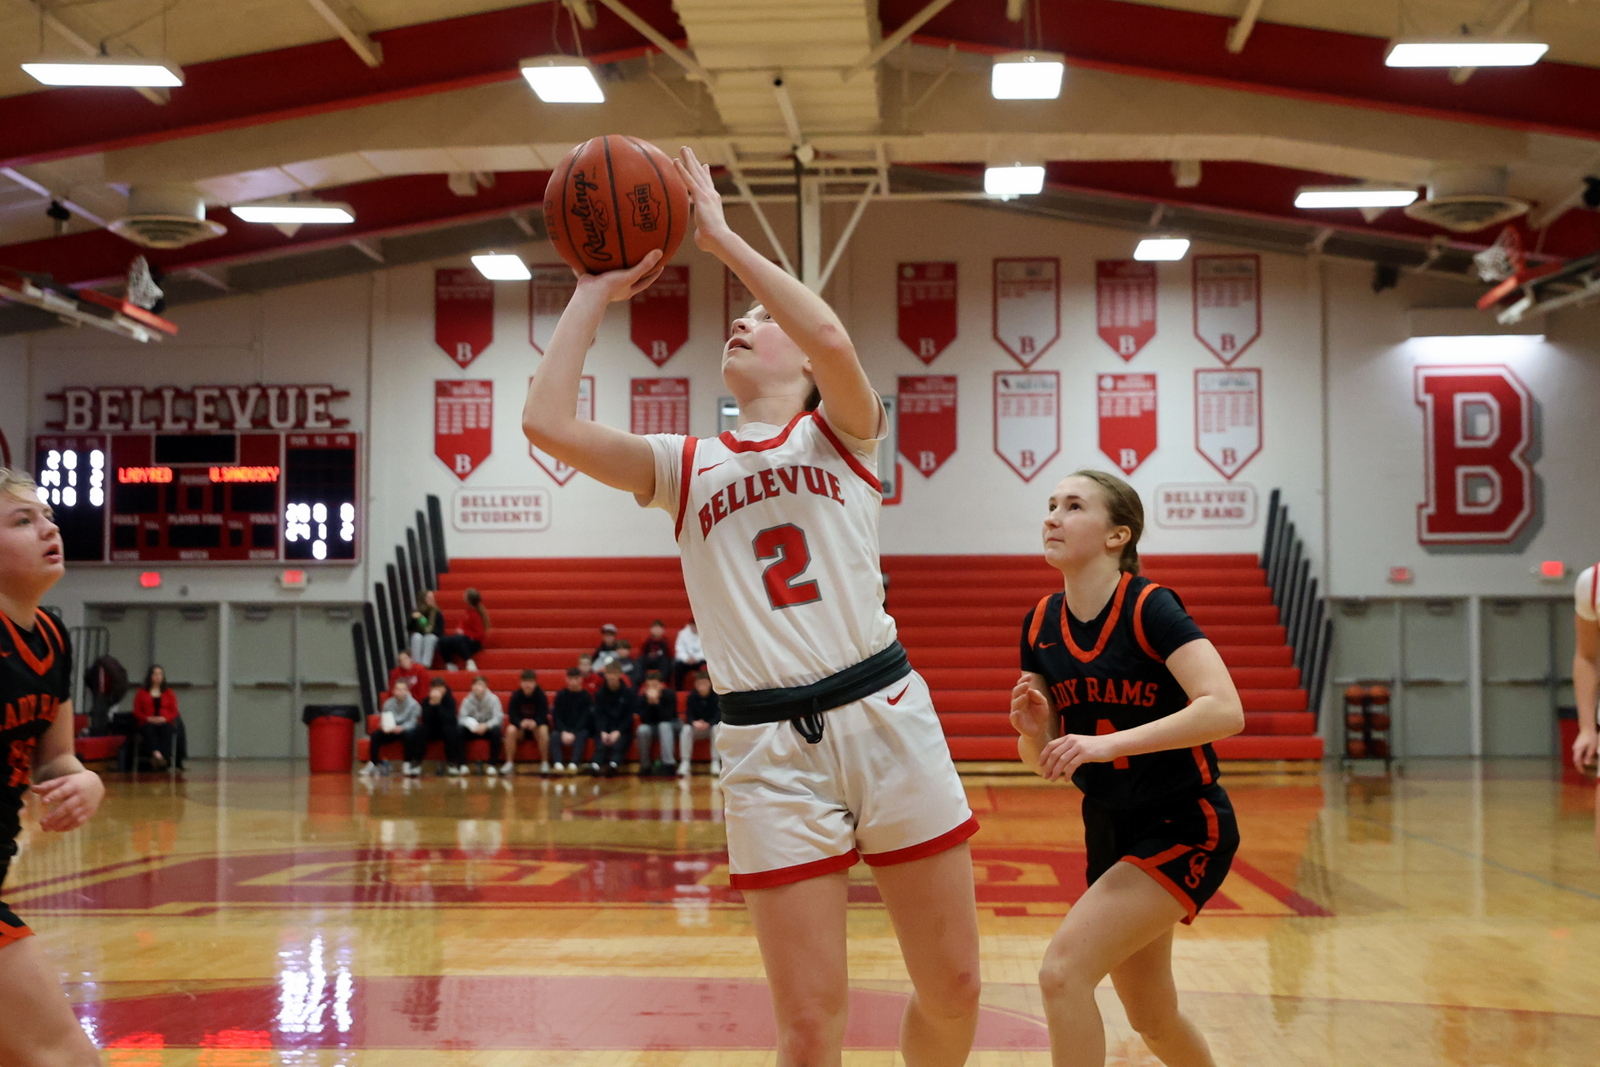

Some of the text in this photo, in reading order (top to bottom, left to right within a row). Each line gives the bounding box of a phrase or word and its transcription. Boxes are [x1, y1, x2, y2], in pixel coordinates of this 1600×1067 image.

[571, 170, 612, 261] Rawlings
[636, 185, 654, 231] OHSAA
[455, 342, 474, 362] B
[651, 339, 668, 360] B
[918, 338, 936, 358] B
[1019, 336, 1036, 355] B
[1118, 335, 1136, 354] B
[1220, 334, 1236, 352] B
[64, 387, 333, 430] BELLEVUE
[455, 454, 472, 473] B
[918, 451, 936, 471] B
[1020, 450, 1035, 468] B
[1119, 449, 1138, 469] B
[1221, 448, 1237, 466] B
[1414, 364, 1534, 546] B
[461, 495, 542, 508] BELLEVUE
[698, 465, 845, 541] BELLEVUE
[1163, 491, 1246, 504] BELLEVUE
[461, 511, 542, 524] STUDENTS
[1202, 507, 1244, 519] BAND
[751, 522, 823, 611] 2
[1085, 677, 1158, 707] RAMS
